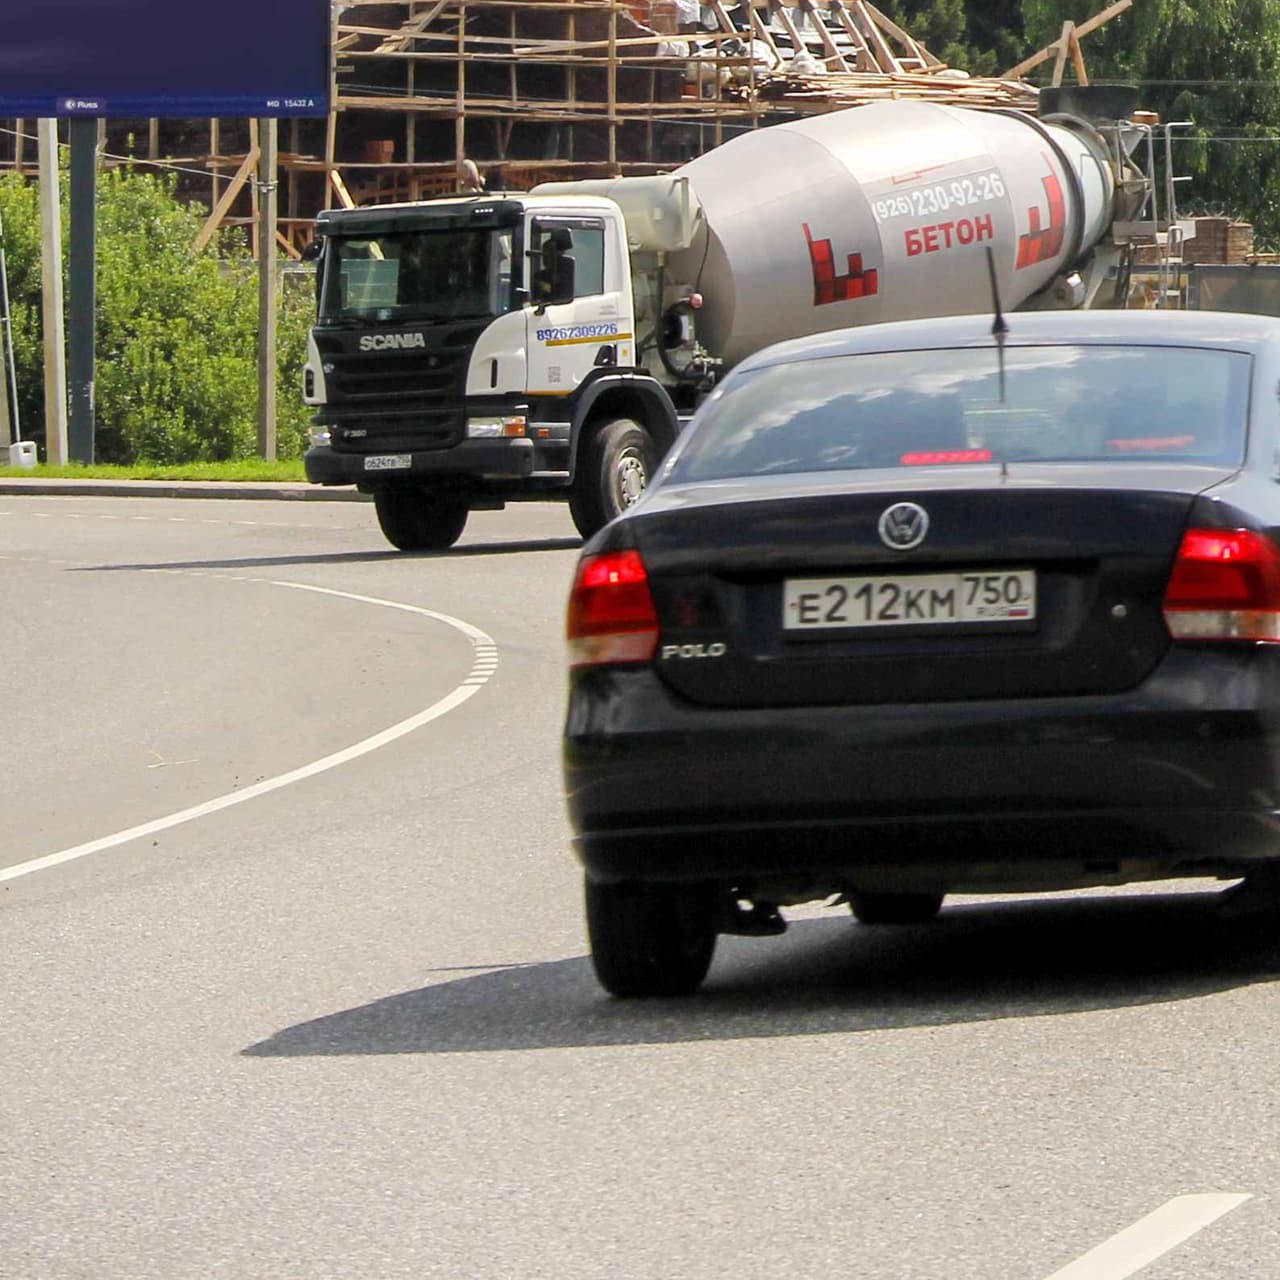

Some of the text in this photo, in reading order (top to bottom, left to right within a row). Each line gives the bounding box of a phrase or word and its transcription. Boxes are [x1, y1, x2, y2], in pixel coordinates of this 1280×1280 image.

[77, 101, 99, 109] Russ
[904, 213, 994, 257] БЕТОН
[536, 323, 618, 341] 89262309226
[359, 332, 426, 351] SCANIA
[662, 642, 726, 660] POLO
